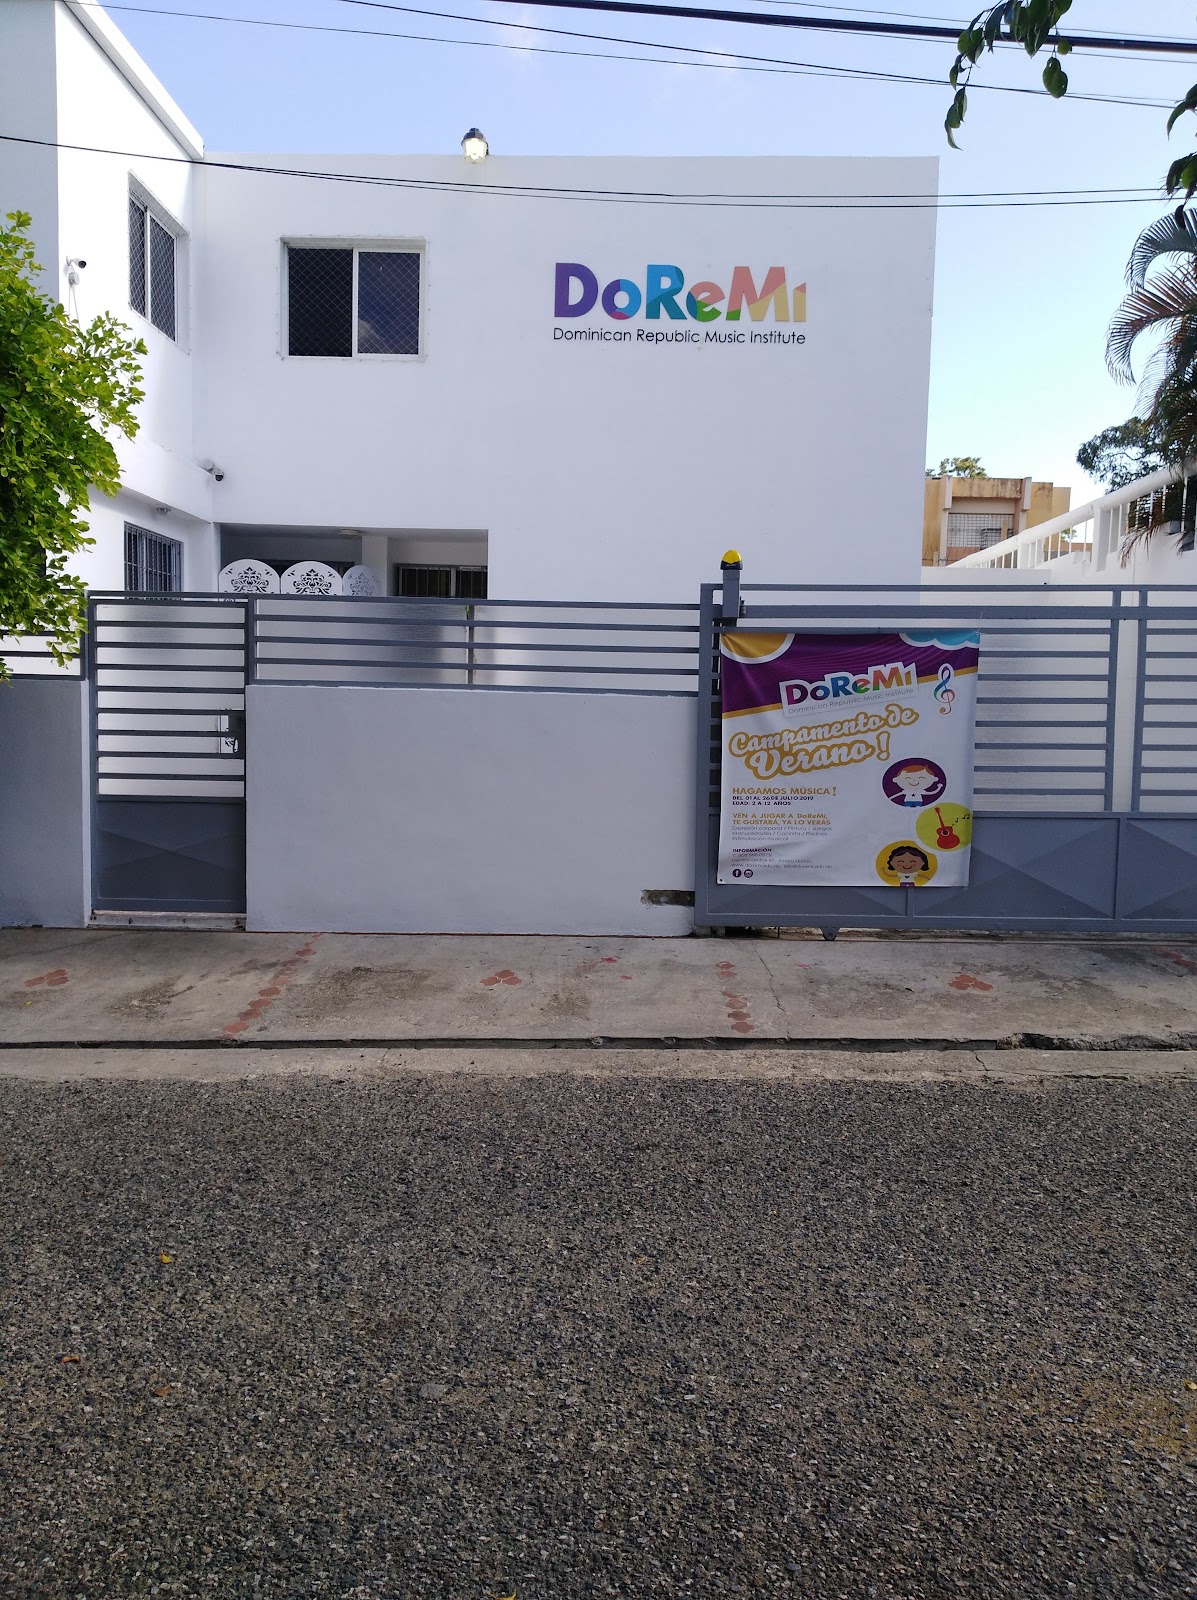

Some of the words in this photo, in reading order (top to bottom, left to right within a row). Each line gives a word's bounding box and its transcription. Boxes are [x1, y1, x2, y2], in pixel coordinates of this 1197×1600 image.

[554, 262, 806, 322] DoReMi
[553, 327, 631, 342] Dominican
[636, 329, 700, 345] Republic
[704, 330, 746, 343] Music
[750, 331, 806, 345] Institute
[785, 666, 913, 705] DoReMi
[788, 703, 828, 714] Dominican
[829, 697, 860, 707] Republic
[863, 693, 883, 702] Music
[885, 688, 914, 698] Institute
[730, 711, 884, 756] Campamento
[885, 704, 919, 728] de
[732, 787, 787, 795] HAGAMOS
[790, 786, 830, 795] MÚSICA
